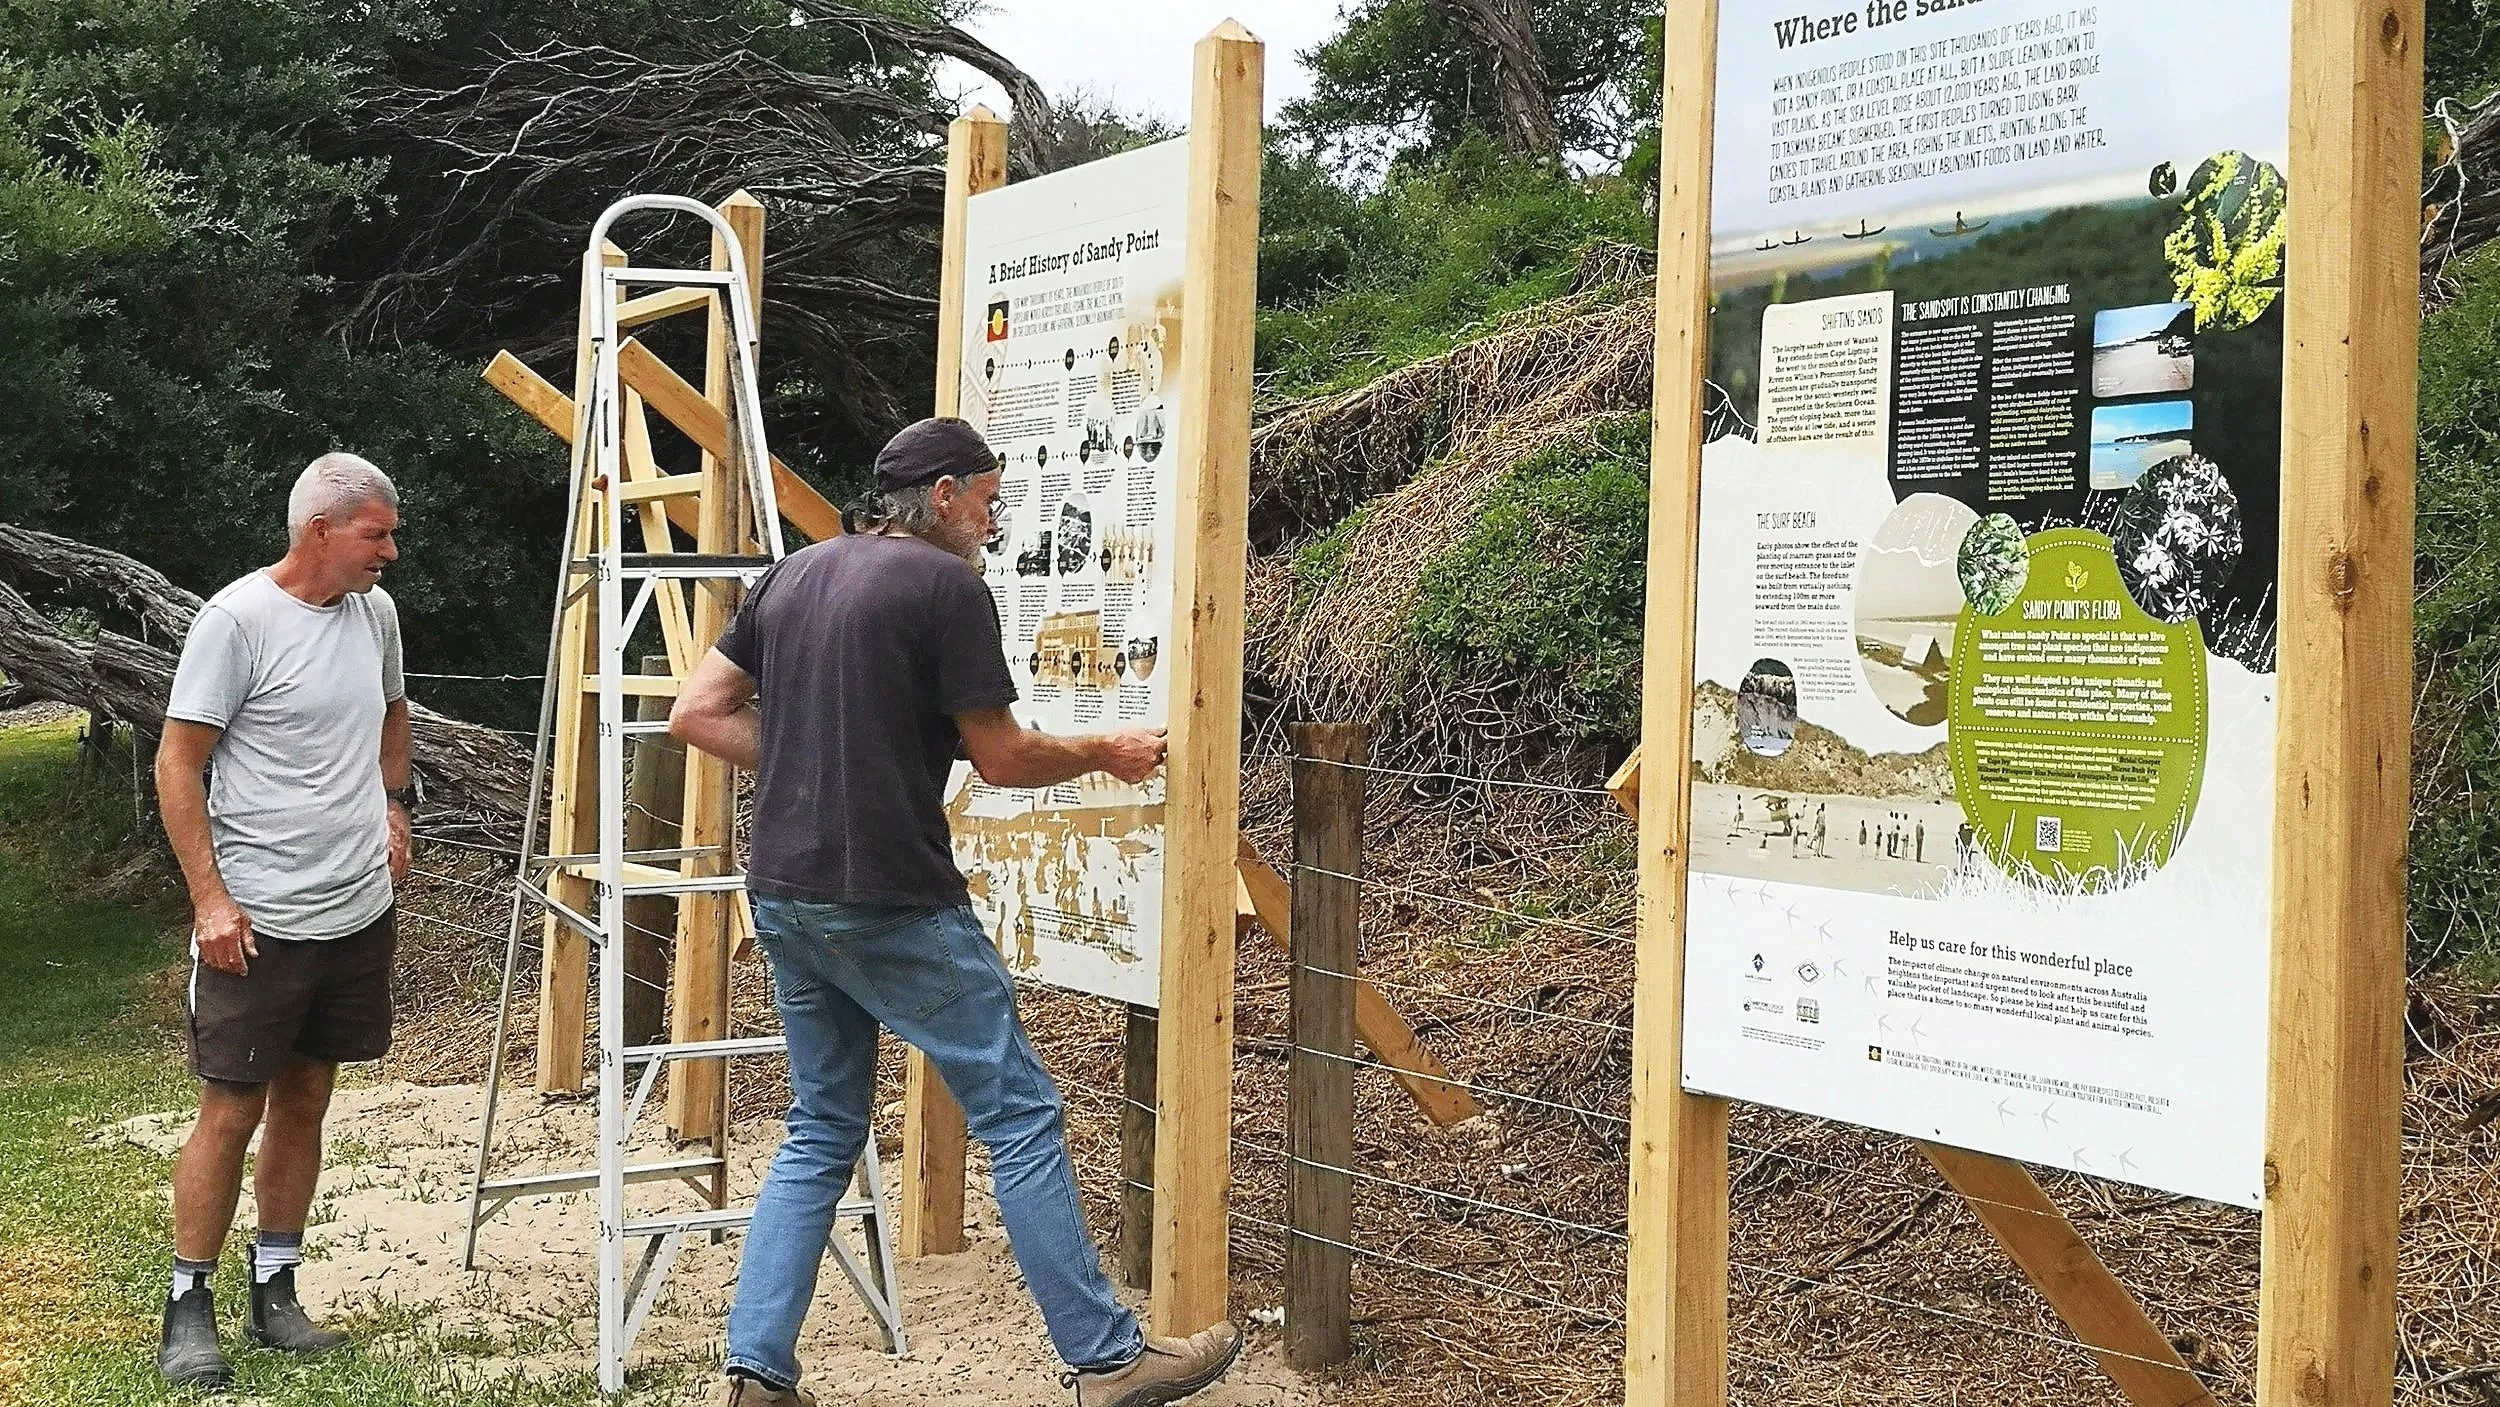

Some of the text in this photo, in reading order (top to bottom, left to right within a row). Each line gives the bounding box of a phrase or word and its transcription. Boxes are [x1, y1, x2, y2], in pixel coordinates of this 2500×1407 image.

[1773, 11, 1857, 49] Where
[1866, 0, 1907, 28] the
[1773, 74, 1793, 94] WHEN
[1795, 64, 1836, 89] INDIGENOUS
[1838, 57, 1867, 80] PEOPLE
[1868, 51, 1894, 74] STOOD
[1896, 48, 1907, 67] ON
[1909, 44, 1927, 64] THIS
[1929, 39, 1948, 60] SITE
[1949, 28, 1998, 56] THOUSANDS
[2000, 25, 2012, 44] OF
[2014, 19, 2041, 40] YEARS
[2067, 10, 2077, 29] IT
[2079, 6, 2097, 26] WAS
[1771, 118, 1790, 137] VAST
[1821, 110, 1831, 128] AS
[1833, 106, 1847, 125] THE
[1849, 104, 1864, 122] SEA
[1866, 98, 1890, 119] LEVEL
[1892, 92, 1913, 114] ROSE
[1914, 87, 1942, 109] ABOUT
[1943, 81, 1971, 104] 12,000
[1972, 75, 1999, 97] YEARS
[2024, 66, 2041, 87] THE
[2043, 61, 2066, 83] LAND
[2069, 54, 2100, 78] BRIDGE
[1772, 97, 1787, 116] NOT
[1788, 96, 1793, 113] A
[1795, 91, 1819, 111] SANDY
[1846, 82, 1856, 101] OR
[1858, 81, 1863, 98] A
[1865, 75, 1899, 96] COASTAL
[1900, 67, 1925, 89] PLACE
[1926, 65, 1938, 84] AT
[1960, 56, 1978, 77] BUT
[1979, 55, 1985, 72] A
[1988, 48, 2015, 71] SLOPE
[2017, 40, 2052, 64] LEADING
[2055, 34, 2080, 56] DOWN
[2082, 31, 2095, 50] TO
[1770, 142, 1780, 160] TO
[1781, 136, 1816, 157] TASMANIA
[1817, 129, 1846, 151] BECAME
[1898, 116, 1914, 135] THE
[1916, 111, 1939, 132] FIRST
[1940, 104, 1976, 127] PEOPLES
[1979, 97, 2011, 120] TURNED
[2014, 94, 2025, 113] TO
[2028, 89, 2053, 111] USING
[2056, 84, 2079, 105] BARK
[988, 228, 1159, 284] A Brief History of Sandy Point
[1822, 307, 1883, 331] SHIFTING SANDS
[1900, 283, 2071, 322] THE SANDSPIT IS CONSTANTLY CHANGING
[1756, 511, 1816, 529] THE SURF BEACH
[1756, 542, 1773, 551] Early
[1773, 541, 1793, 551] photos
[1794, 541, 1810, 549] show
[1821, 540, 1839, 548] effect
[1840, 540, 1847, 548] of
[2022, 599, 2121, 621] SANDY POINT'S FLORA
[1981, 629, 2166, 642] What makes Sandy Point so special is that we live
[1889, 930, 2132, 977] Help us care for this wonderful place
[1887, 967, 1920, 979] heightens
[1921, 972, 1932, 981] the
[1933, 974, 1969, 986] important
[1970, 980, 1983, 988] and
[1985, 983, 2009, 993] urgent
[2010, 987, 2028, 995] need
[2038, 989, 2055, 999] look
[2056, 992, 2075, 1002] after
[2076, 994, 2091, 1004] this
[2092, 997, 2128, 1010] beautiful
[2129, 1004, 2145, 1013] and
[1887, 978, 1916, 990] valuable
[1918, 983, 1941, 993] pocket
[1942, 986, 1949, 994] of
[1990, 993, 1999, 1002] So
[2000, 995, 2024, 1006] please
[2025, 998, 2034, 1008] be
[2035, 999, 2053, 1010] kind
[2054, 1004, 2069, 1013] and
[2070, 1005, 2087, 1017] help
[2099, 1012, 2117, 1020] care
[2119, 1012, 2131, 1022] for
[2132, 1015, 2147, 1025] this
[1888, 956, 1901, 965] The
[1902, 959, 1926, 970] impact
[1927, 962, 1935, 970] of
[1935, 963, 1962, 974] climate
[1963, 967, 1990, 980] change
[2001, 974, 2028, 984] natural
[2030, 978, 2082, 992] environments
[2084, 986, 2109, 996] across
[2110, 988, 2147, 1001] Australia
[1887, 988, 1905, 998] place
[1906, 991, 1920, 1000] that
[1921, 993, 1927, 1002] is
[1934, 995, 1954, 1006] home
[1955, 999, 1962, 1007] to
[1973, 1003, 1993, 1014] many
[1995, 1007, 2032, 1019] wonderful
[2034, 1010, 2052, 1021] local
[2053, 1014, 2073, 1025] plant
[2075, 1016, 2090, 1027] and
[2091, 1022, 2119, 1032] animal
